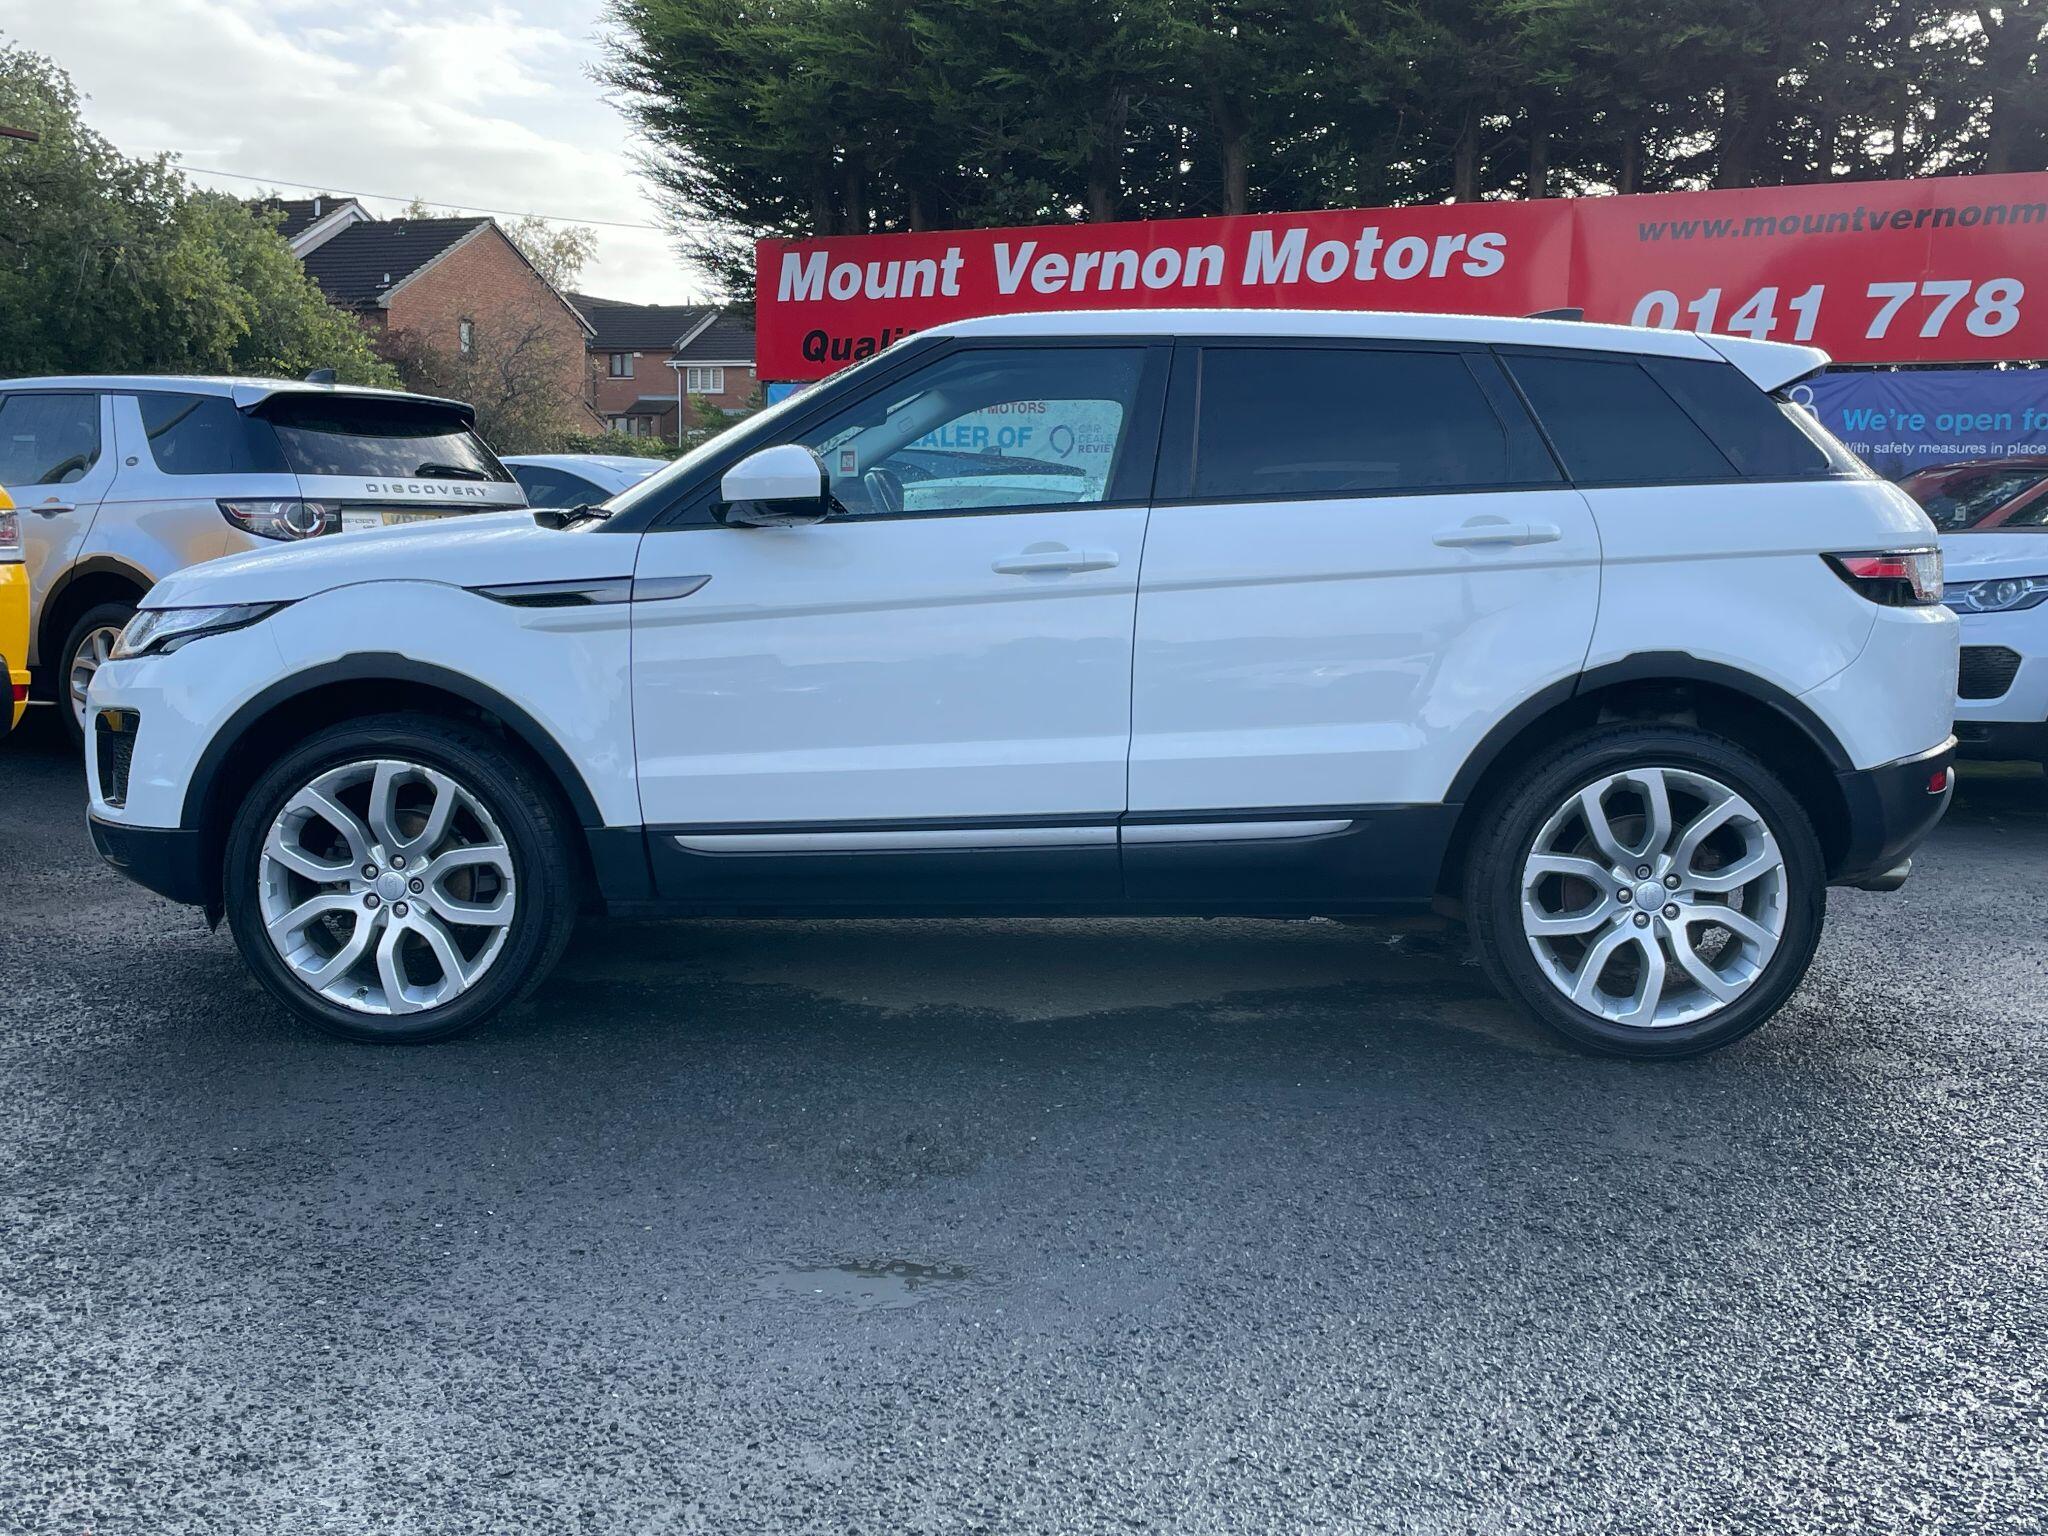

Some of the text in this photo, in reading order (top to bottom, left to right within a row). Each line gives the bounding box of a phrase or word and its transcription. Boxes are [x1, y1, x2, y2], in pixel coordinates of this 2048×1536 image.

[1638, 202, 2047, 242] www.mountvernonm
[777, 226, 1508, 302] Mount Vernon Motors
[1631, 278, 2025, 341] 0141 778
[988, 402, 1046, 415] MOTORS
[1842, 408, 1926, 432] We're
[1935, 410, 2012, 436] open
[911, 424, 1033, 449] ALER OF
[1079, 434, 1114, 444] DEALE
[1079, 444, 1114, 454] REVIE
[1873, 441, 1914, 457] safety
[1919, 443, 1987, 455] measures
[1991, 442, 2004, 454] in
[2007, 442, 2047, 457] place
[366, 483, 487, 497] DISCOVERY
